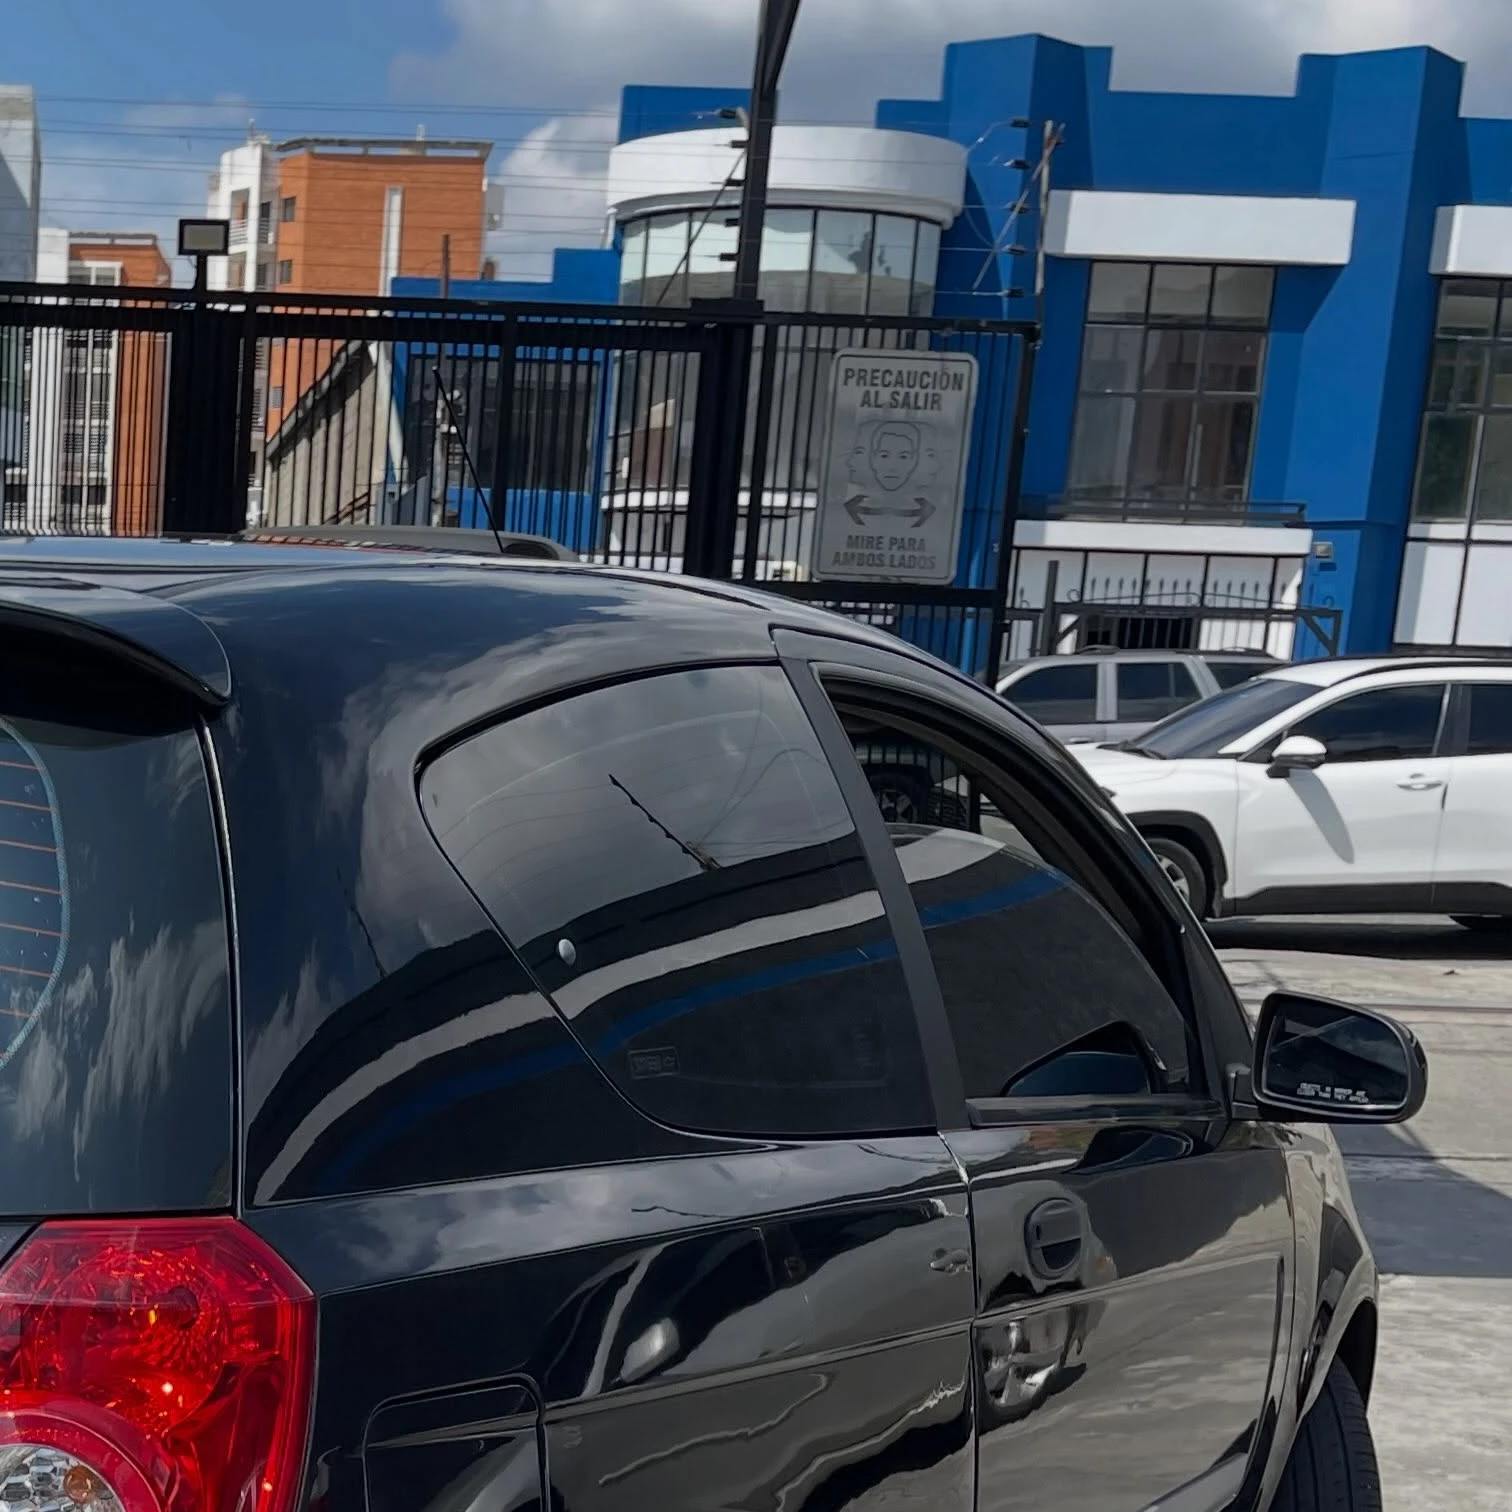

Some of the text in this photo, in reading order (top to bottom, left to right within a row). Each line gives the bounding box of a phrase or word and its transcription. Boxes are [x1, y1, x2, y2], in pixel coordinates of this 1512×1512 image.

[843, 366, 965, 392] PRECAUCIÓN
[859, 390, 943, 411] AL SALIR
[846, 535, 926, 553] MIRE PARA
[832, 551, 936, 570] AMBOS LADOS
